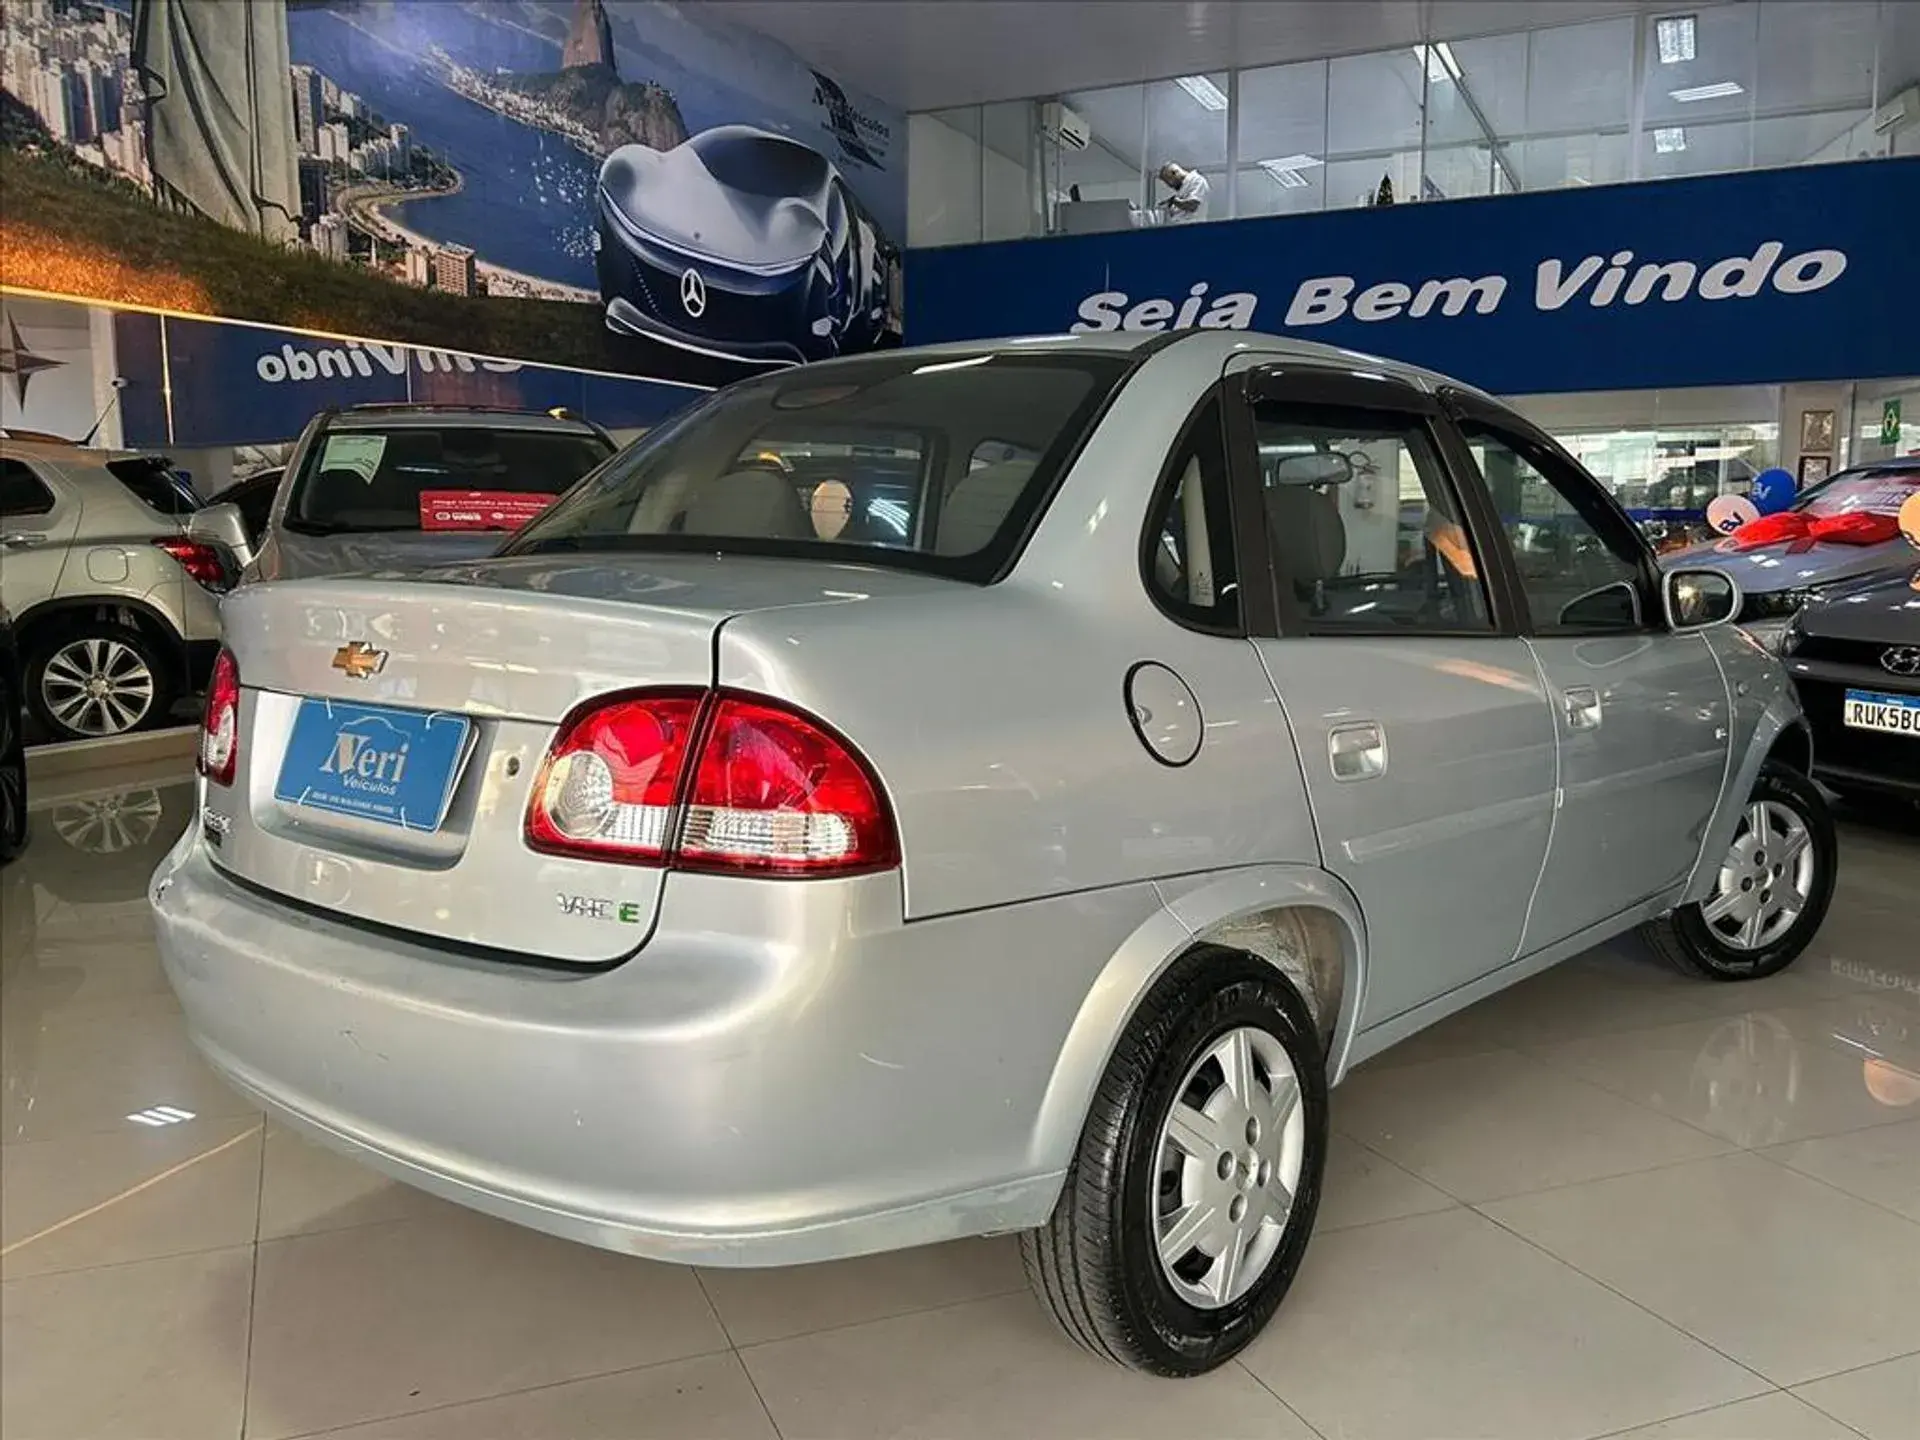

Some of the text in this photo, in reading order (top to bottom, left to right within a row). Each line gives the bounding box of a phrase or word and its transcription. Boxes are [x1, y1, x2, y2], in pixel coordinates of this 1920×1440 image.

[1284, 275, 1508, 326] Bem
[1535, 240, 1848, 311] Vindo
[318, 730, 410, 784] Neri
